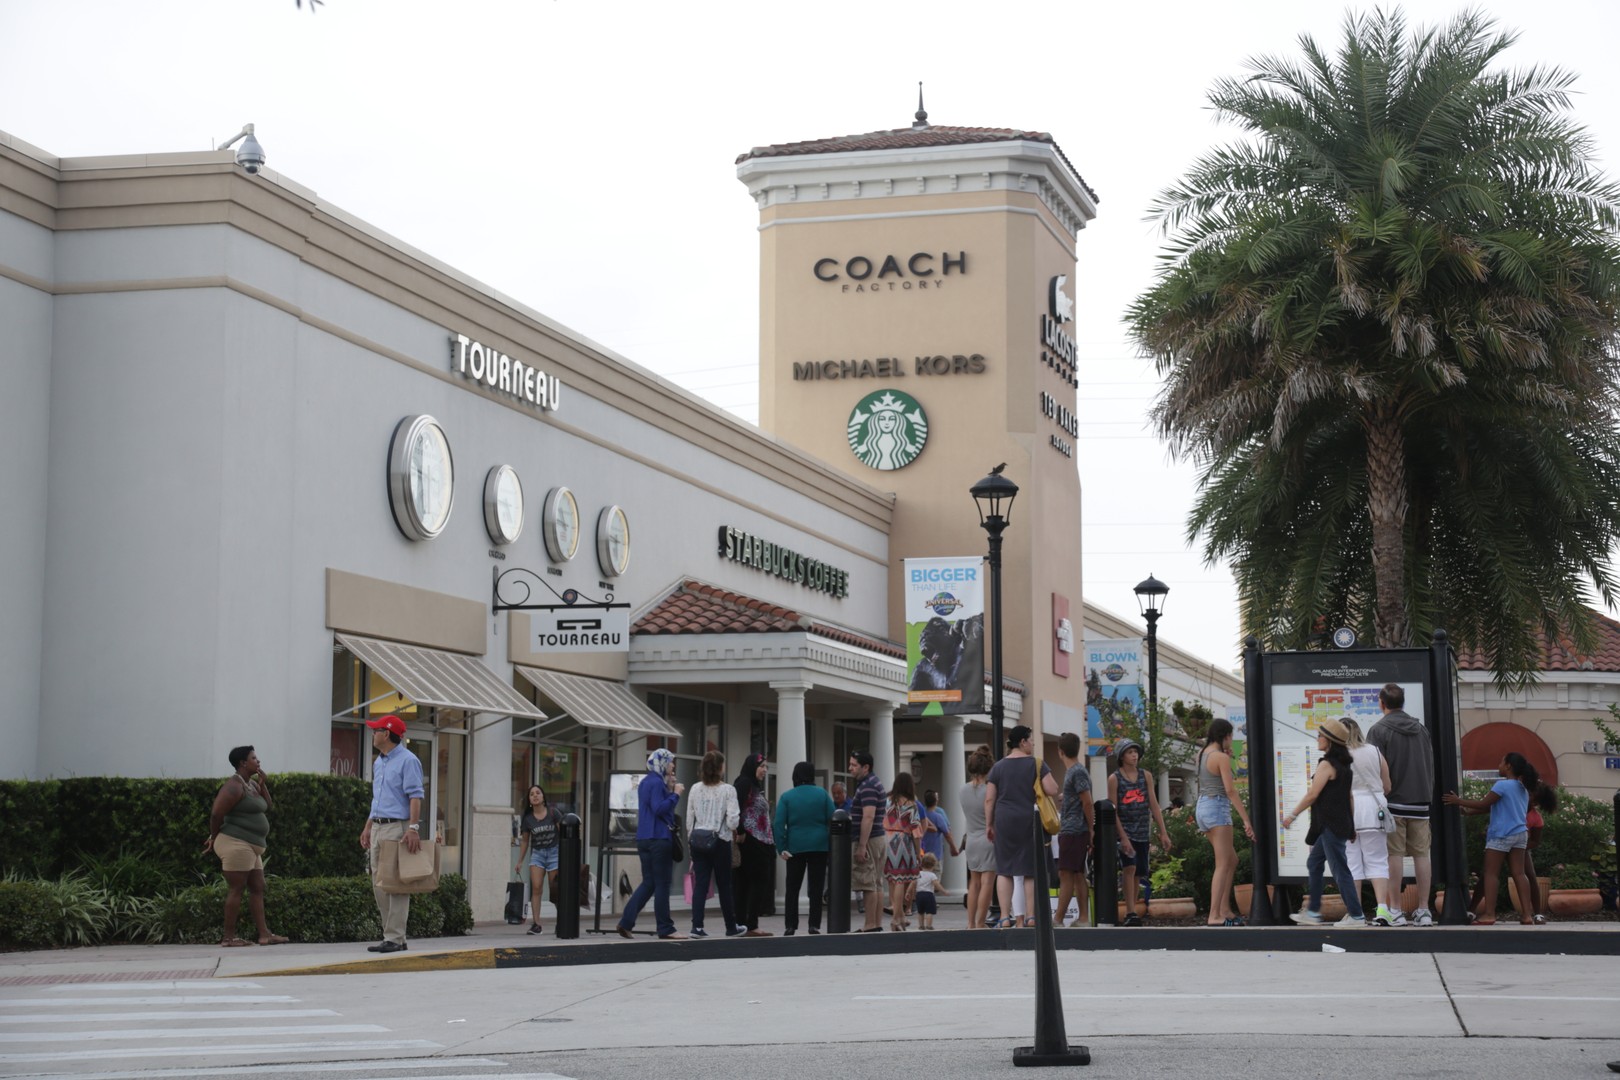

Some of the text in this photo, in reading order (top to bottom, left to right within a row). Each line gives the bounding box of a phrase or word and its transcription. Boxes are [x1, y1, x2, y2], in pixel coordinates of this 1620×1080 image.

[813, 251, 966, 282] COACH
[842, 279, 943, 293] FACTORY
[455, 334, 560, 411] TOURNEAU
[793, 354, 986, 381] MICHAEL KORS
[719, 525, 849, 599] STARBUCKS COFFEE
[911, 568, 977, 583] BIGGER
[912, 583, 957, 592] THAN LIFE
[538, 633, 620, 646] TOURNEAU
